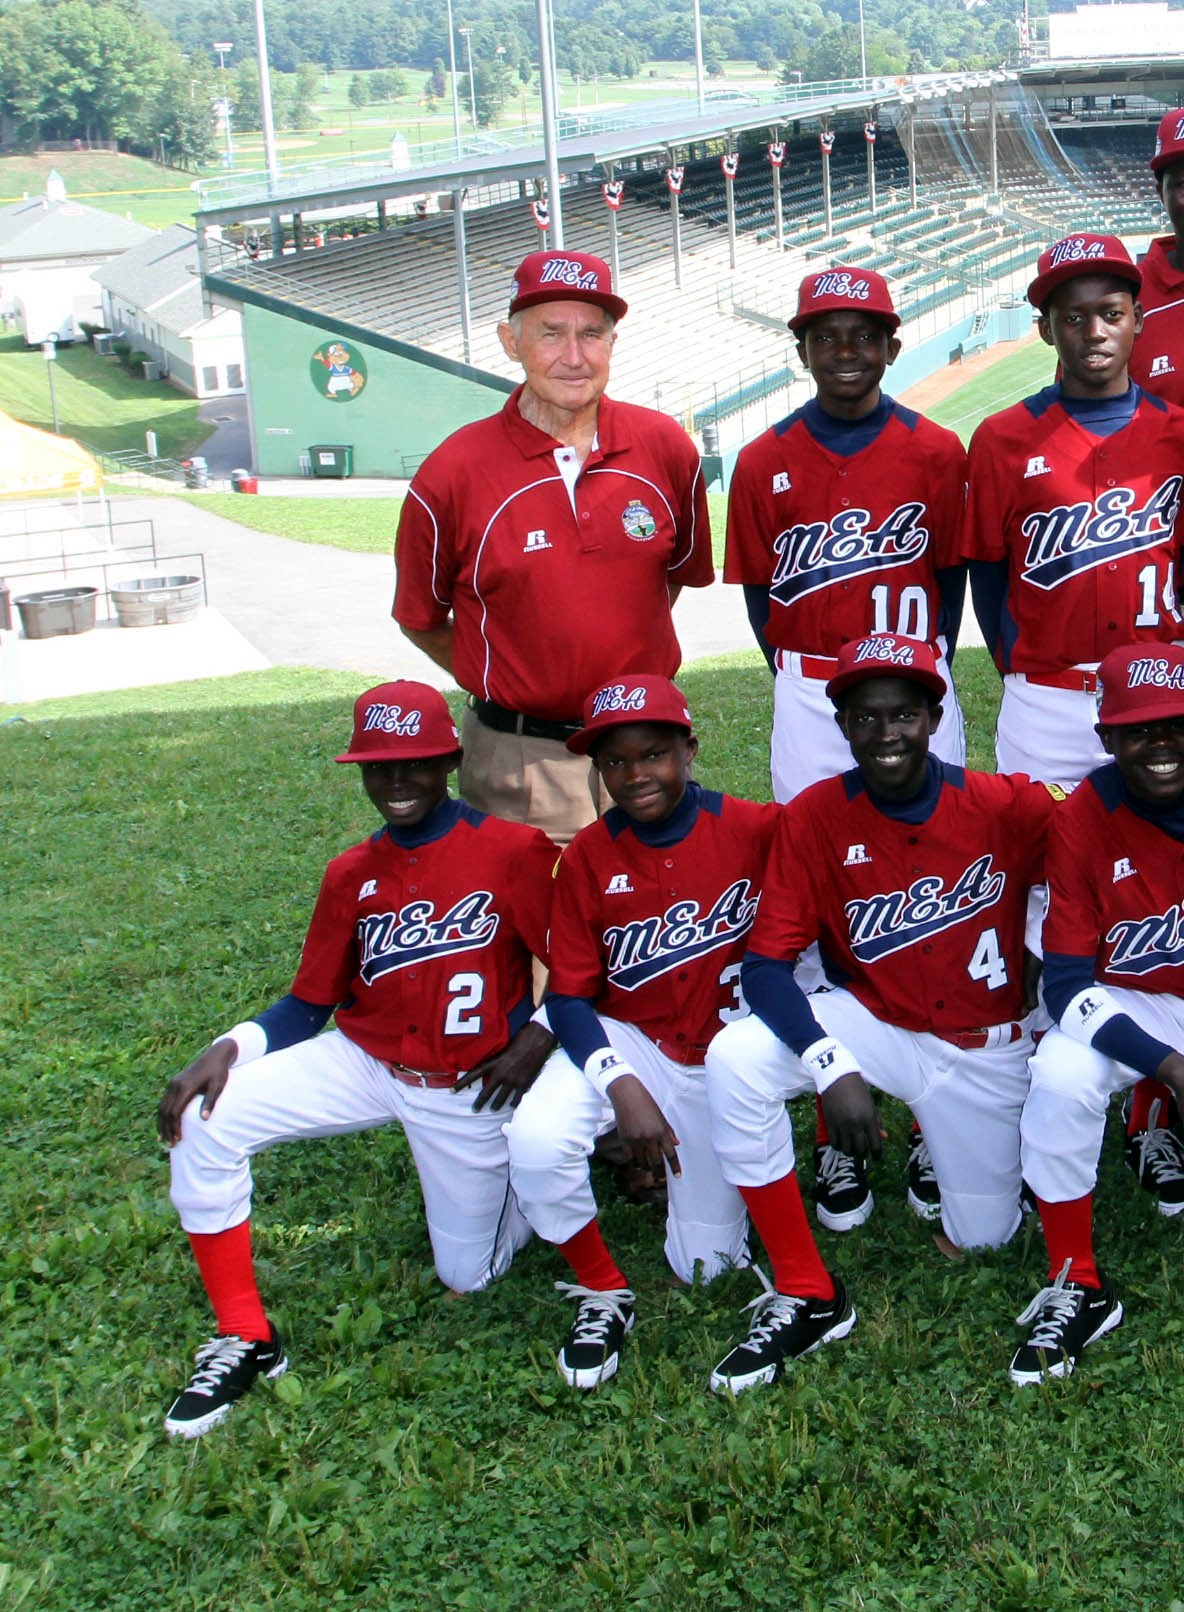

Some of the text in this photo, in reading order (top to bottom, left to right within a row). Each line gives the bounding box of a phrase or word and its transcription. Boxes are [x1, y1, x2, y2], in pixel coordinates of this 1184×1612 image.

[1050, 237, 1105, 269] MEA
[540, 259, 598, 290] MEA
[811, 272, 869, 300] MEA
[1151, 355, 1169, 371] R
[1026, 455, 1045, 472] R
[772, 471, 789, 489] R
[1022, 475, 1183, 567] MEA
[527, 530, 546, 546] R
[771, 502, 928, 583] MEA
[870, 585, 928, 641] 10
[854, 636, 915, 667] MEA
[592, 684, 647, 719] MEA
[363, 703, 422, 736] MEA
[847, 844, 865, 859] R
[1114, 857, 1129, 877] R
[360, 879, 377, 896] R
[609, 874, 628, 889] R
[845, 854, 1000, 943] MEA
[357, 891, 496, 965] MEA
[603, 879, 756, 971] MEA
[967, 927, 1008, 991] 4
[444, 972, 485, 1035] 2
